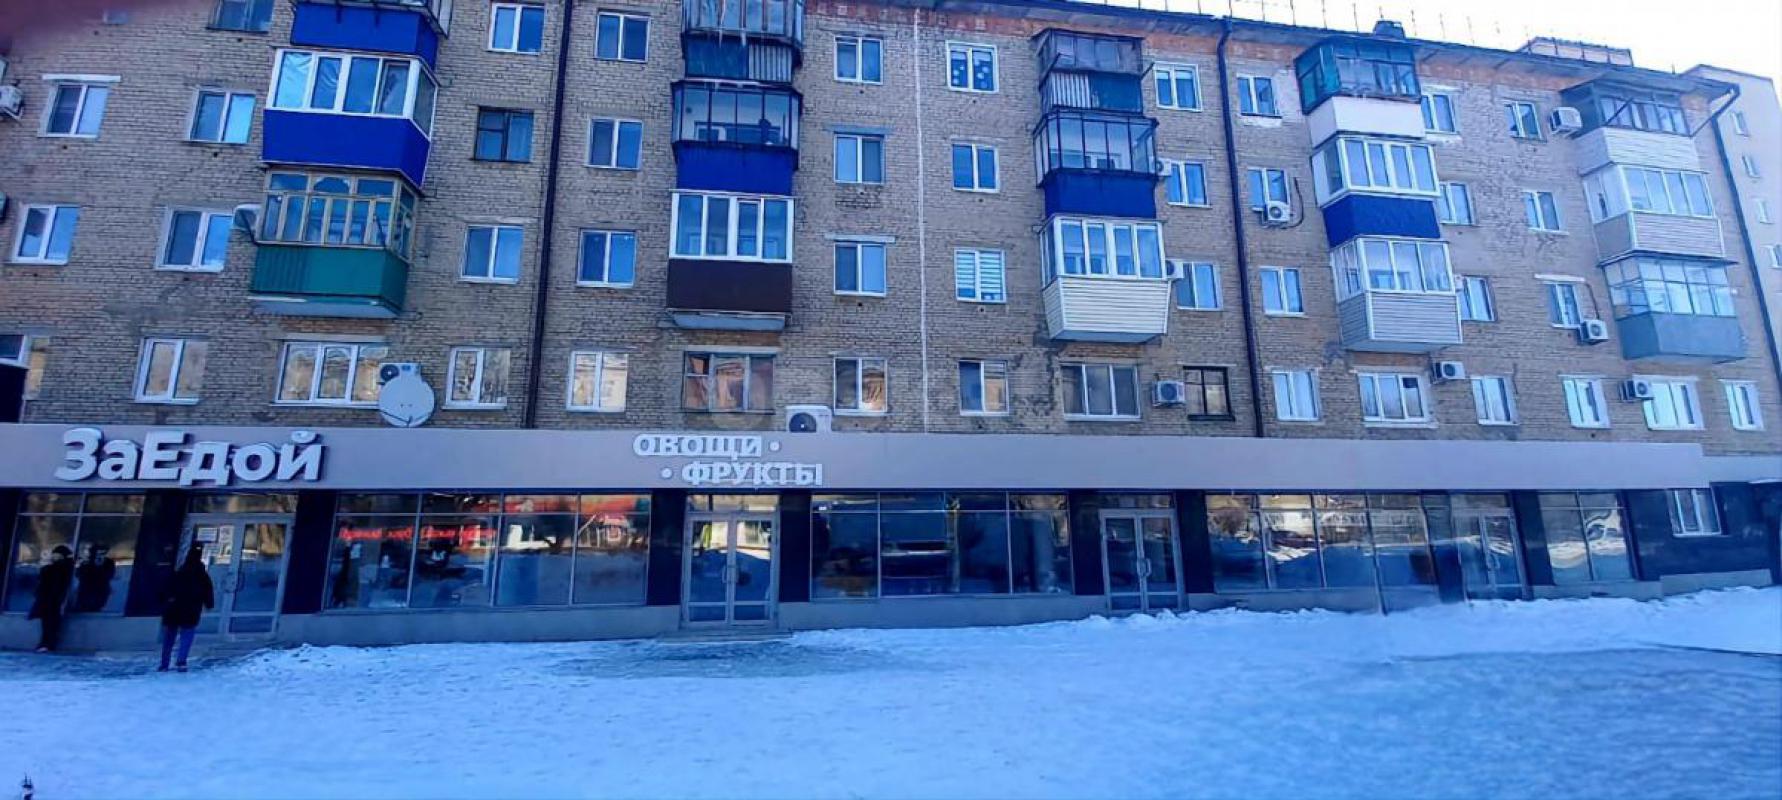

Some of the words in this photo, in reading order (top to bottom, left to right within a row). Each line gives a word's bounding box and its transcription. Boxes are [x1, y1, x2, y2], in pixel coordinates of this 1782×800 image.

[54, 427, 325, 486] ЗаЕдой
[633, 434, 762, 460] ОВОЩИ
[681, 460, 823, 486] ФРУКТЫ
